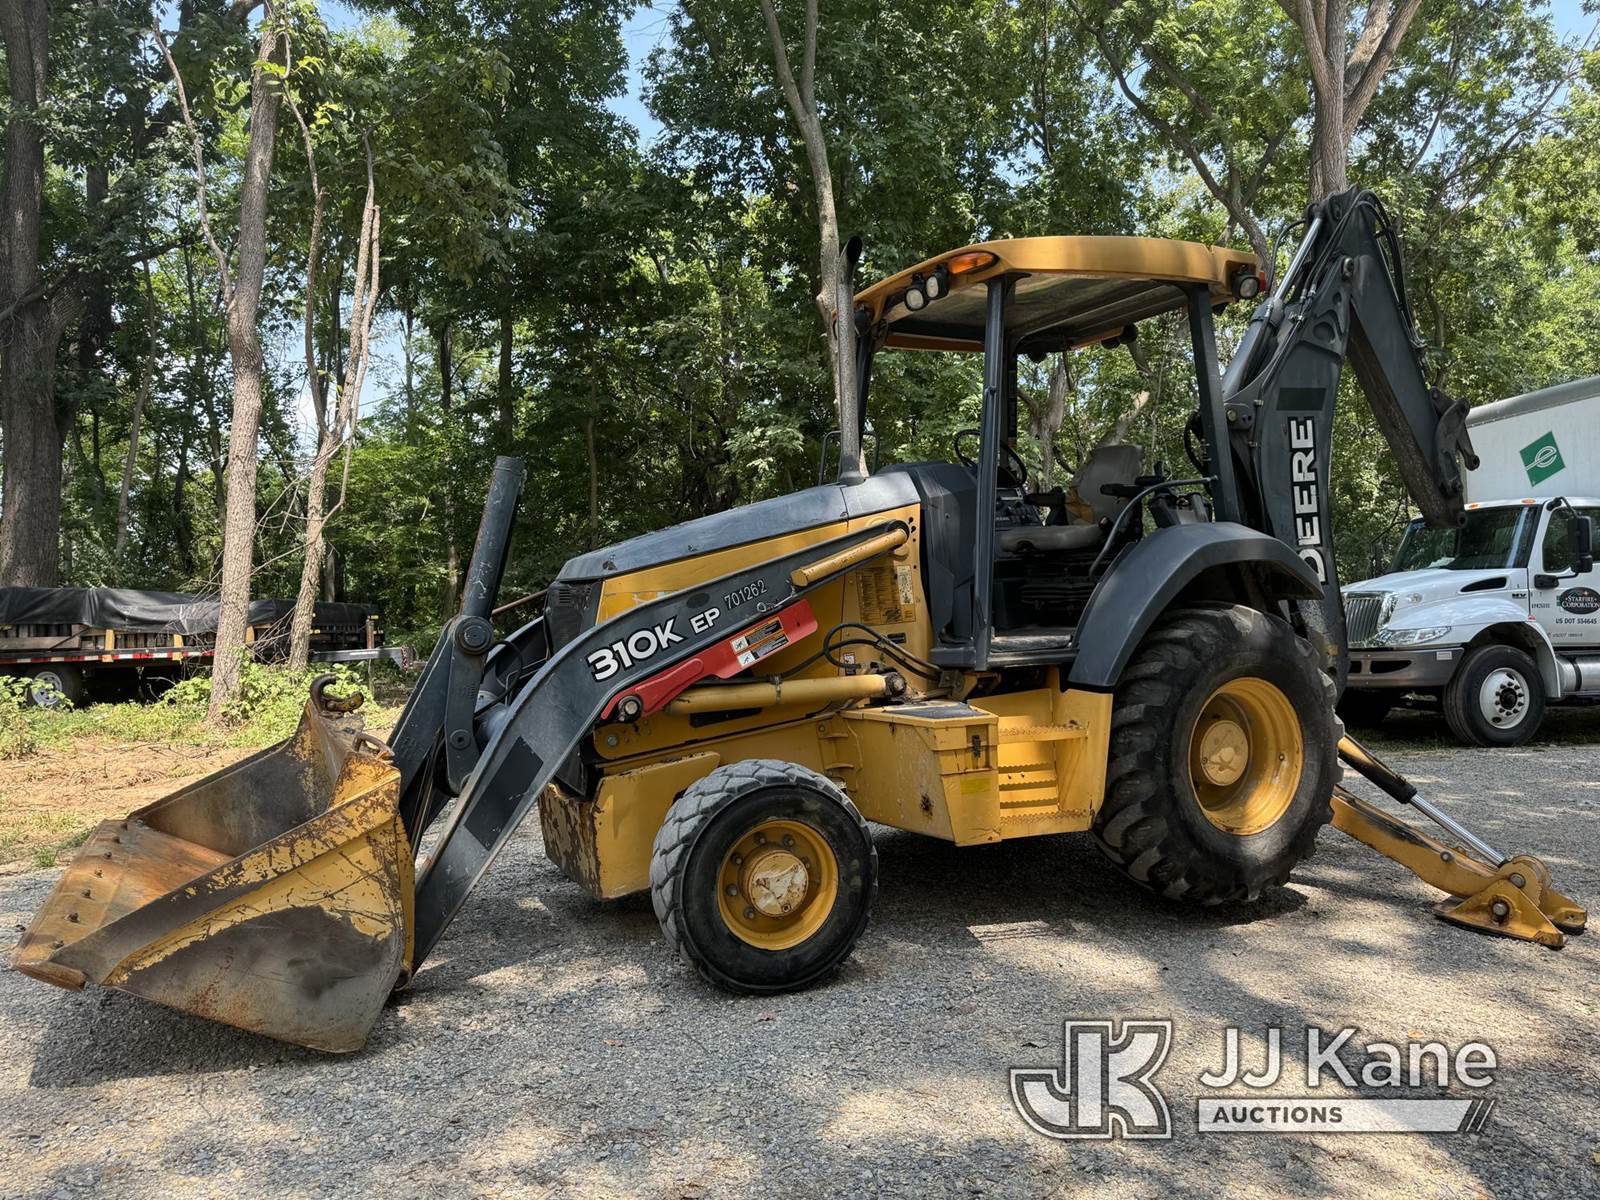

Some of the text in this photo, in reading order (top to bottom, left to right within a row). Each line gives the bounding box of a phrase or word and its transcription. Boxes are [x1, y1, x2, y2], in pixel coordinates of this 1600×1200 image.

[1290, 418, 1327, 583] DEERE
[587, 579, 768, 681] 310K EP 701262
